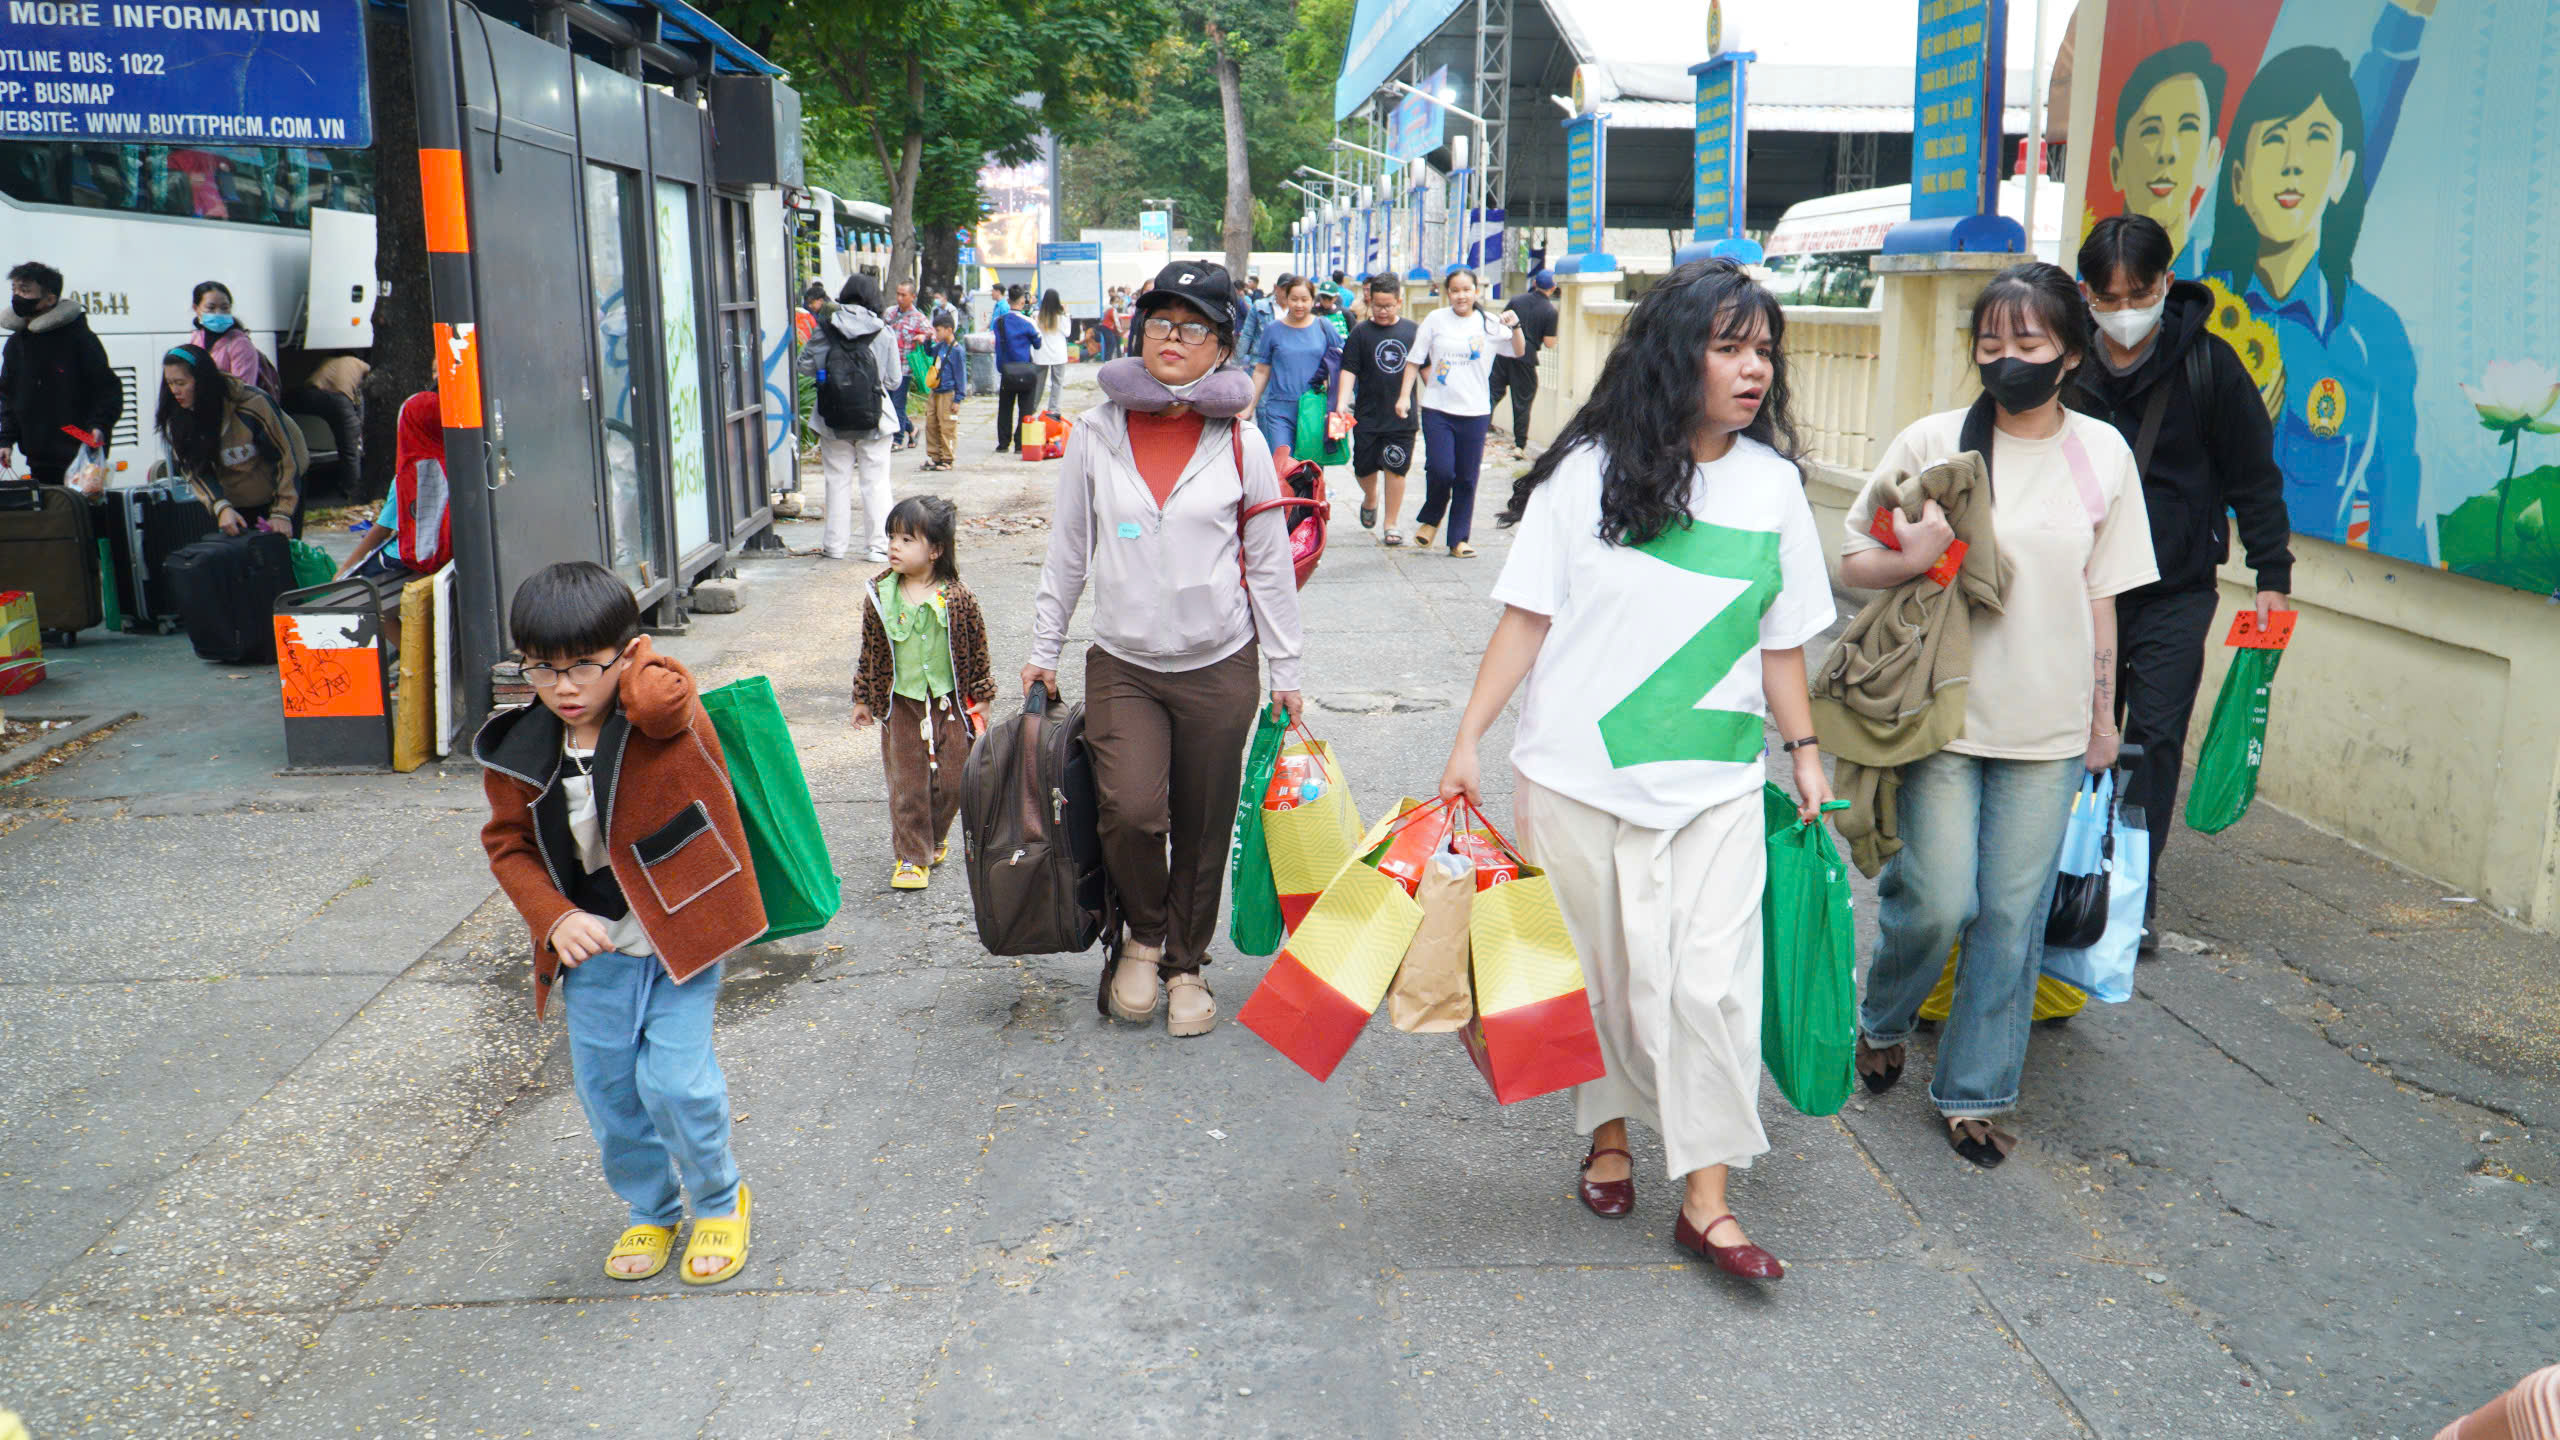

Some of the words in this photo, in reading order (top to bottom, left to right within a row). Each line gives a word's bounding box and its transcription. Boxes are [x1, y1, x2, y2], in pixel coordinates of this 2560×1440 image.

[10, 1, 101, 27] MORE
[113, 5, 321, 33] INFORMATION
[68, 52, 113, 74] BUS:
[120, 54, 165, 75] 1022
[35, 82, 114, 104] BUSMAP
[0, 110, 79, 132] EBSITE:
[86, 113, 345, 139] WWW.BUYTTPHCM.COM.VN
[619, 1236, 657, 1248] VANS
